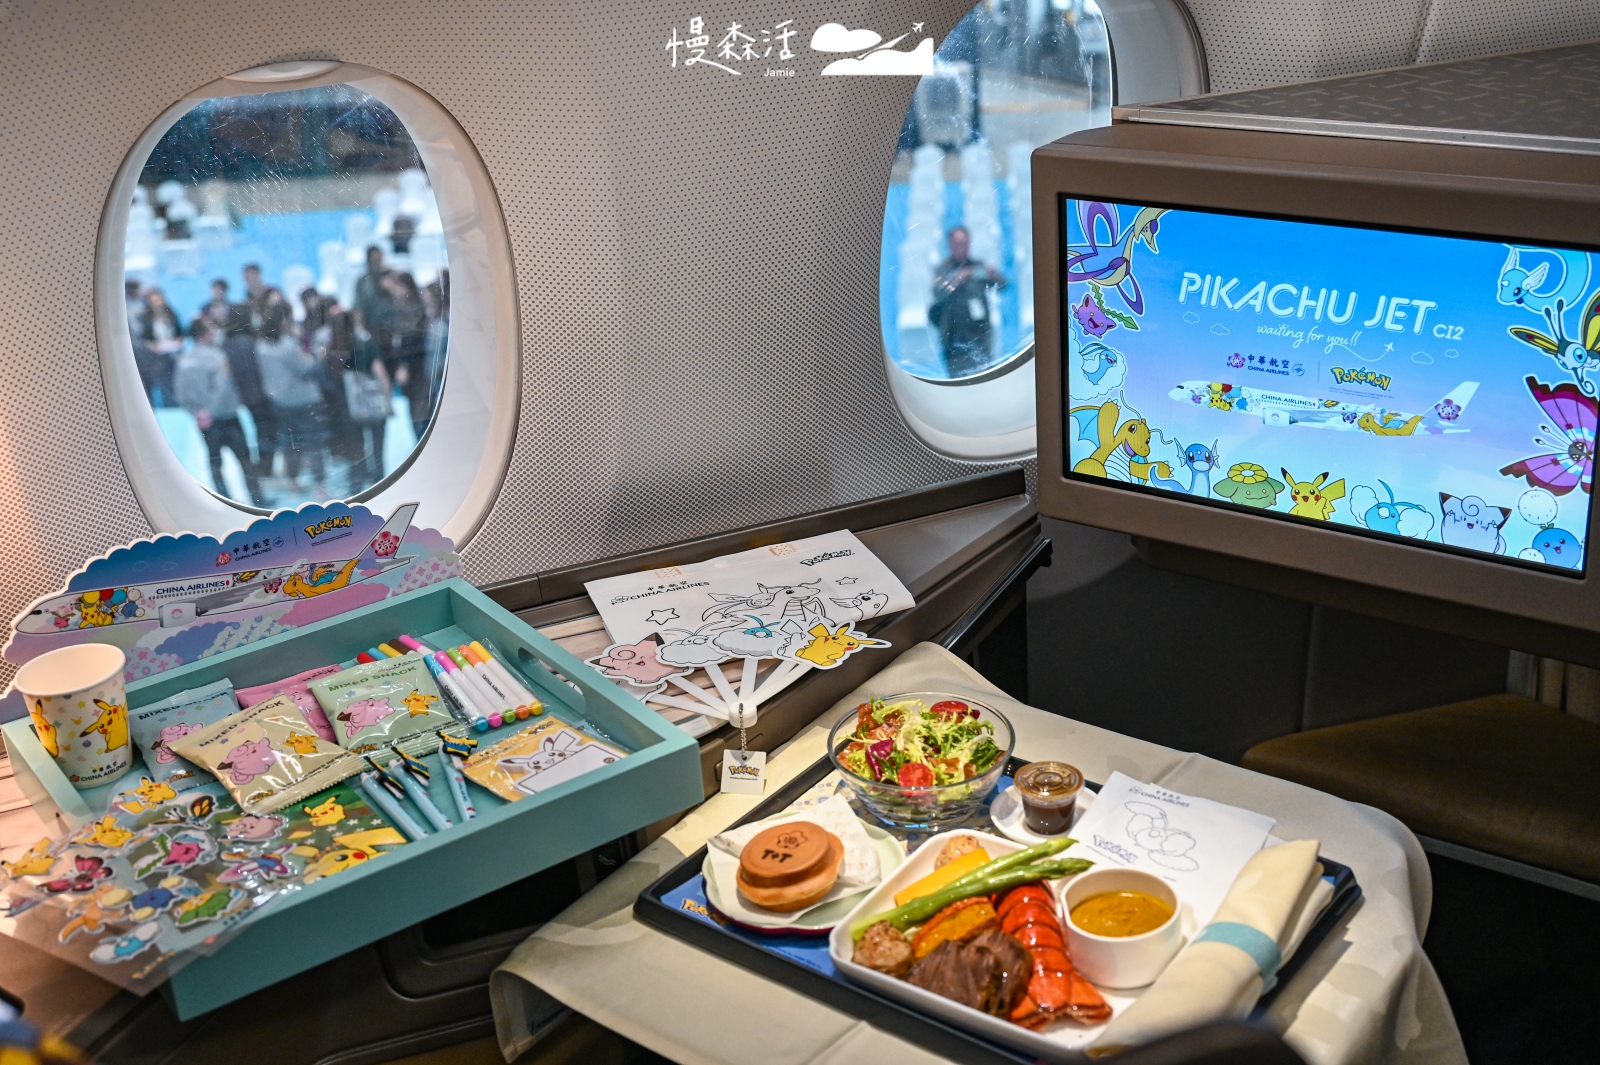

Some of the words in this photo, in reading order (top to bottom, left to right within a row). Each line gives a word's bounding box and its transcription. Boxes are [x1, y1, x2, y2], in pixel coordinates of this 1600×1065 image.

[1179, 272, 1358, 325] PIKACHU
[1363, 295, 1439, 335] JET
[1257, 324, 1304, 348] waiting
[1306, 326, 1325, 344] for
[1247, 354, 1290, 369] 中華航空
[1247, 365, 1265, 373] CHINA
[1265, 368, 1290, 376] AIRLINES
[1261, 394, 1282, 402] CHINA
[1283, 397, 1313, 407] AIRLINES
[233, 538, 271, 555] 中華航空
[156, 586, 185, 595] CHINA
[186, 580, 226, 591] AIRLINES
[630, 590, 664, 600] CHINA
[666, 581, 710, 592] AIRLINES
[328, 678, 369, 692] MIXED
[372, 665, 417, 680] SNACK
[138, 705, 180, 720] MIXED
[199, 724, 238, 747] MIXED
[81, 773, 102, 782] CHINA
[103, 761, 127, 776] AIRLINES
